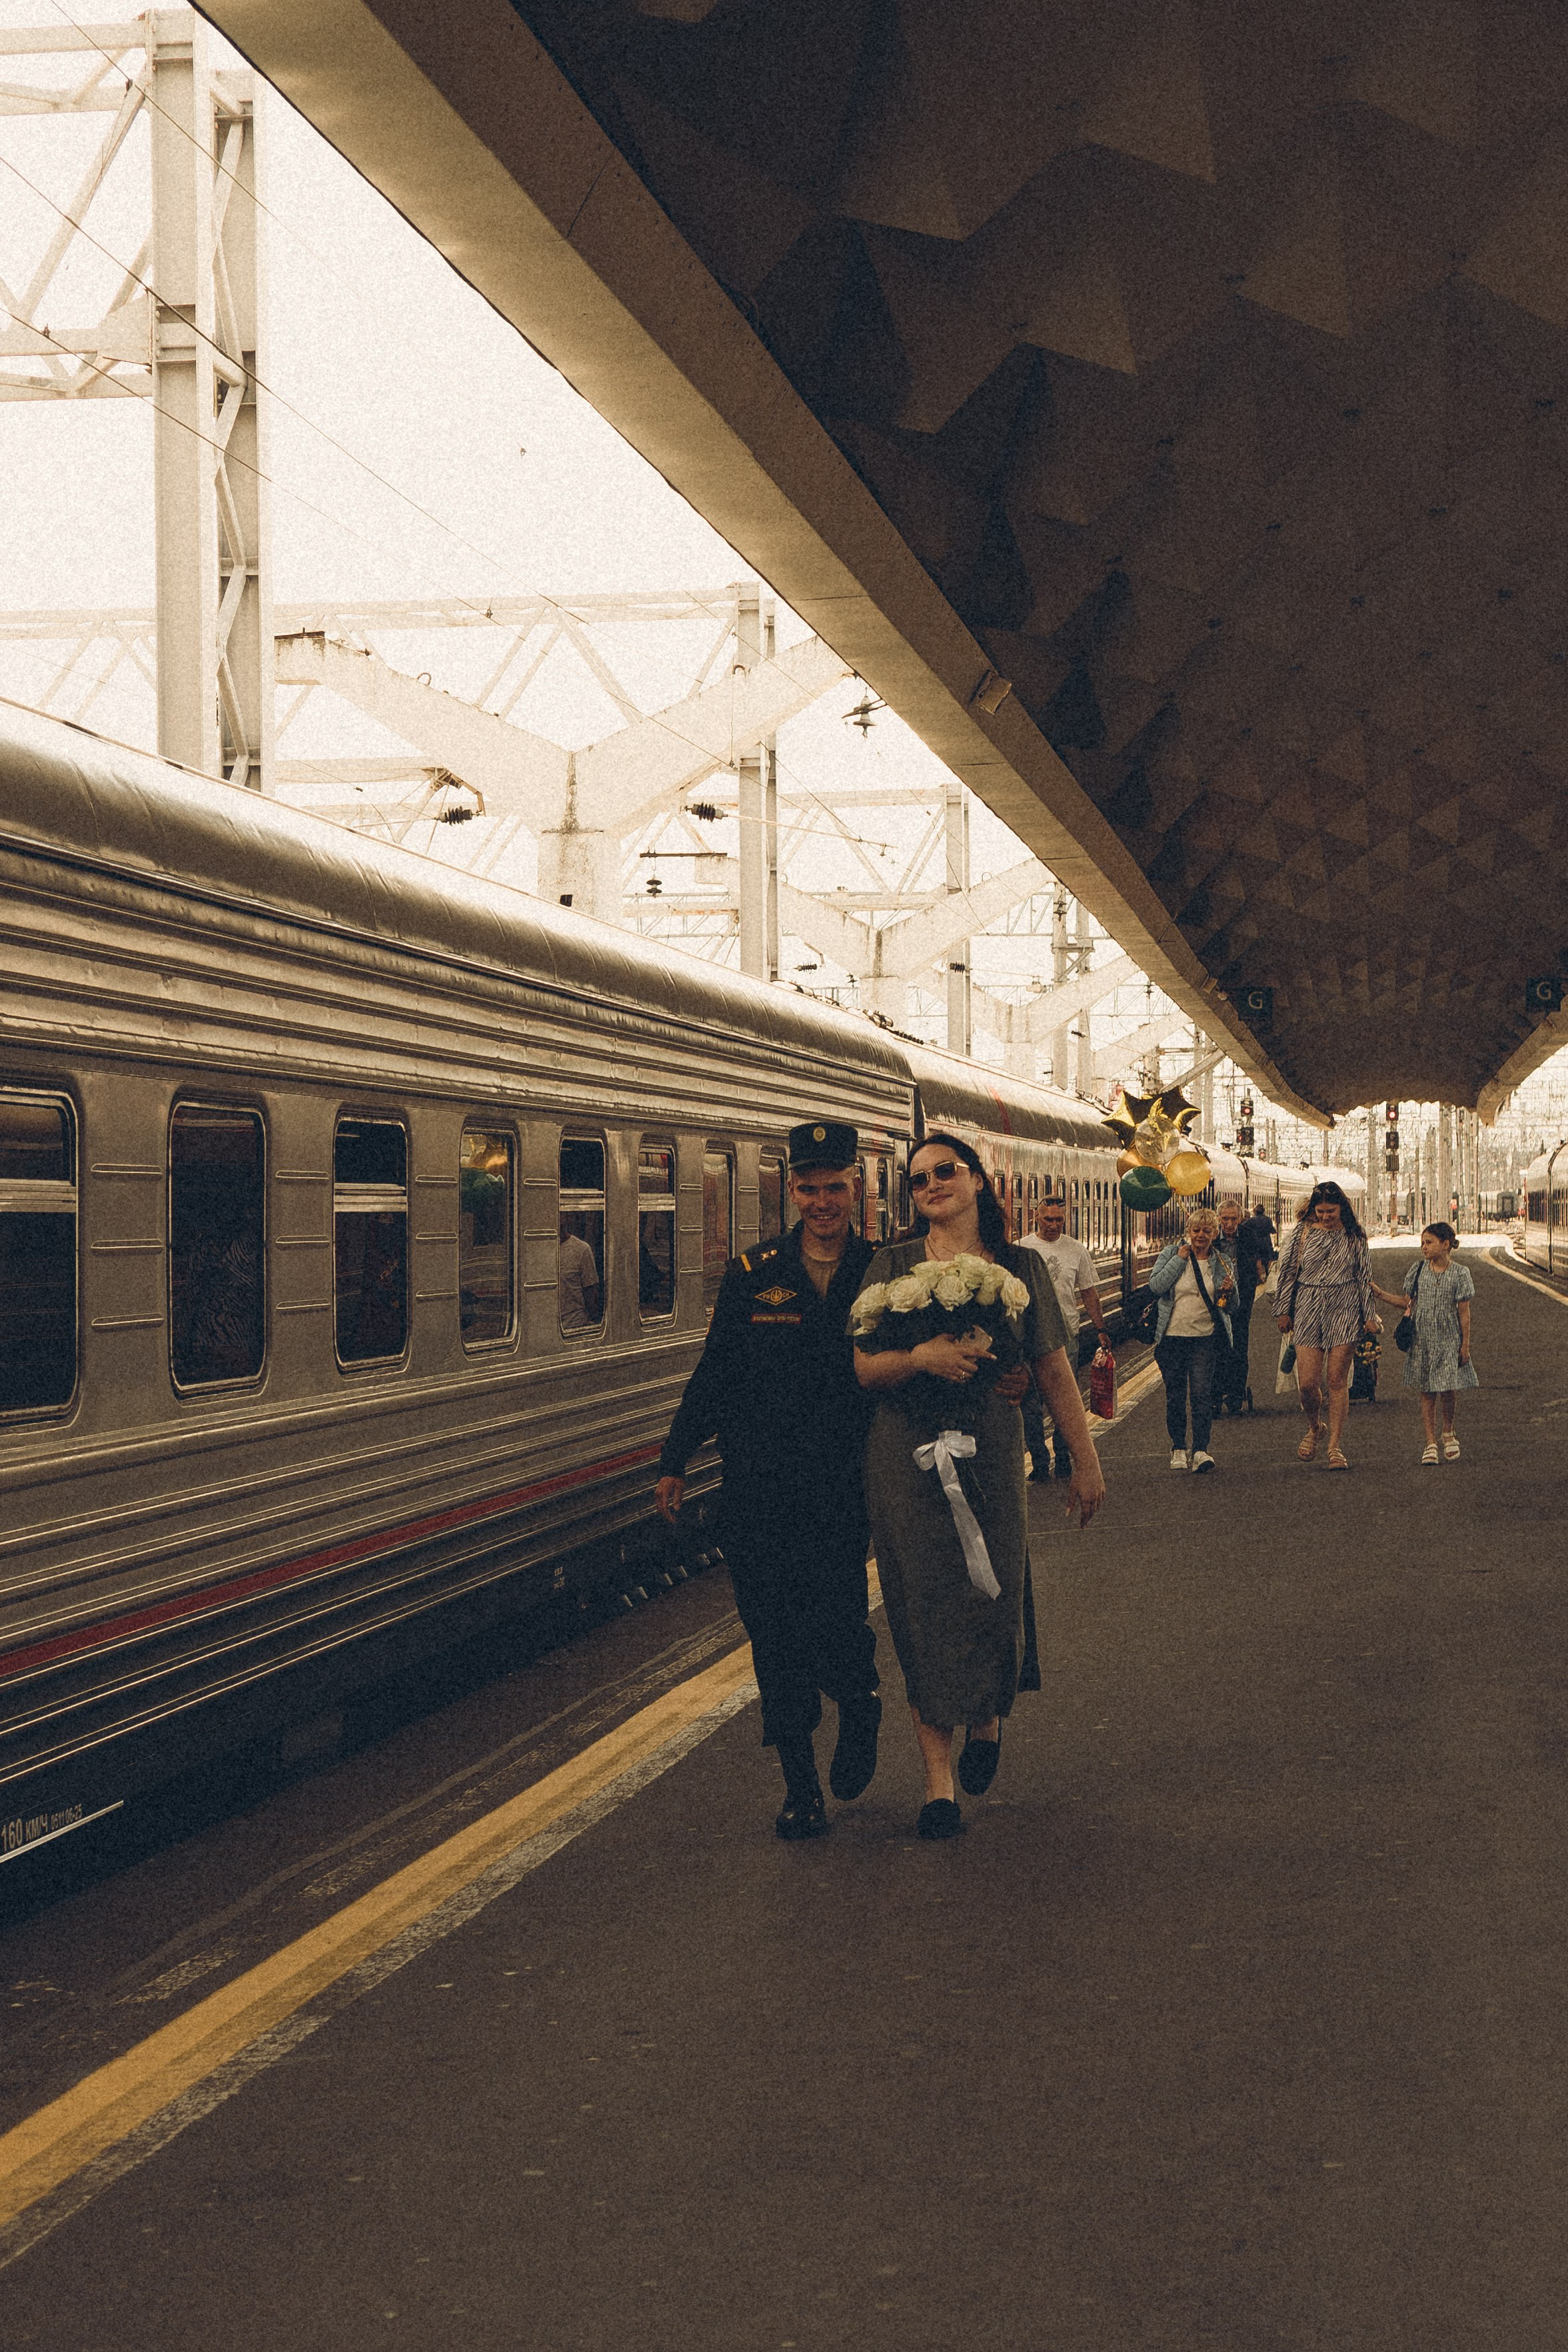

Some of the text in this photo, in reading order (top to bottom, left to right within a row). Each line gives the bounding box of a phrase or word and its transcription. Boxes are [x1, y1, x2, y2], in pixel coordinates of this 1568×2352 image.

[1536, 981, 1552, 1000] G
[1247, 991, 1263, 1010] G
[1, 1818, 23, 1851] 160
